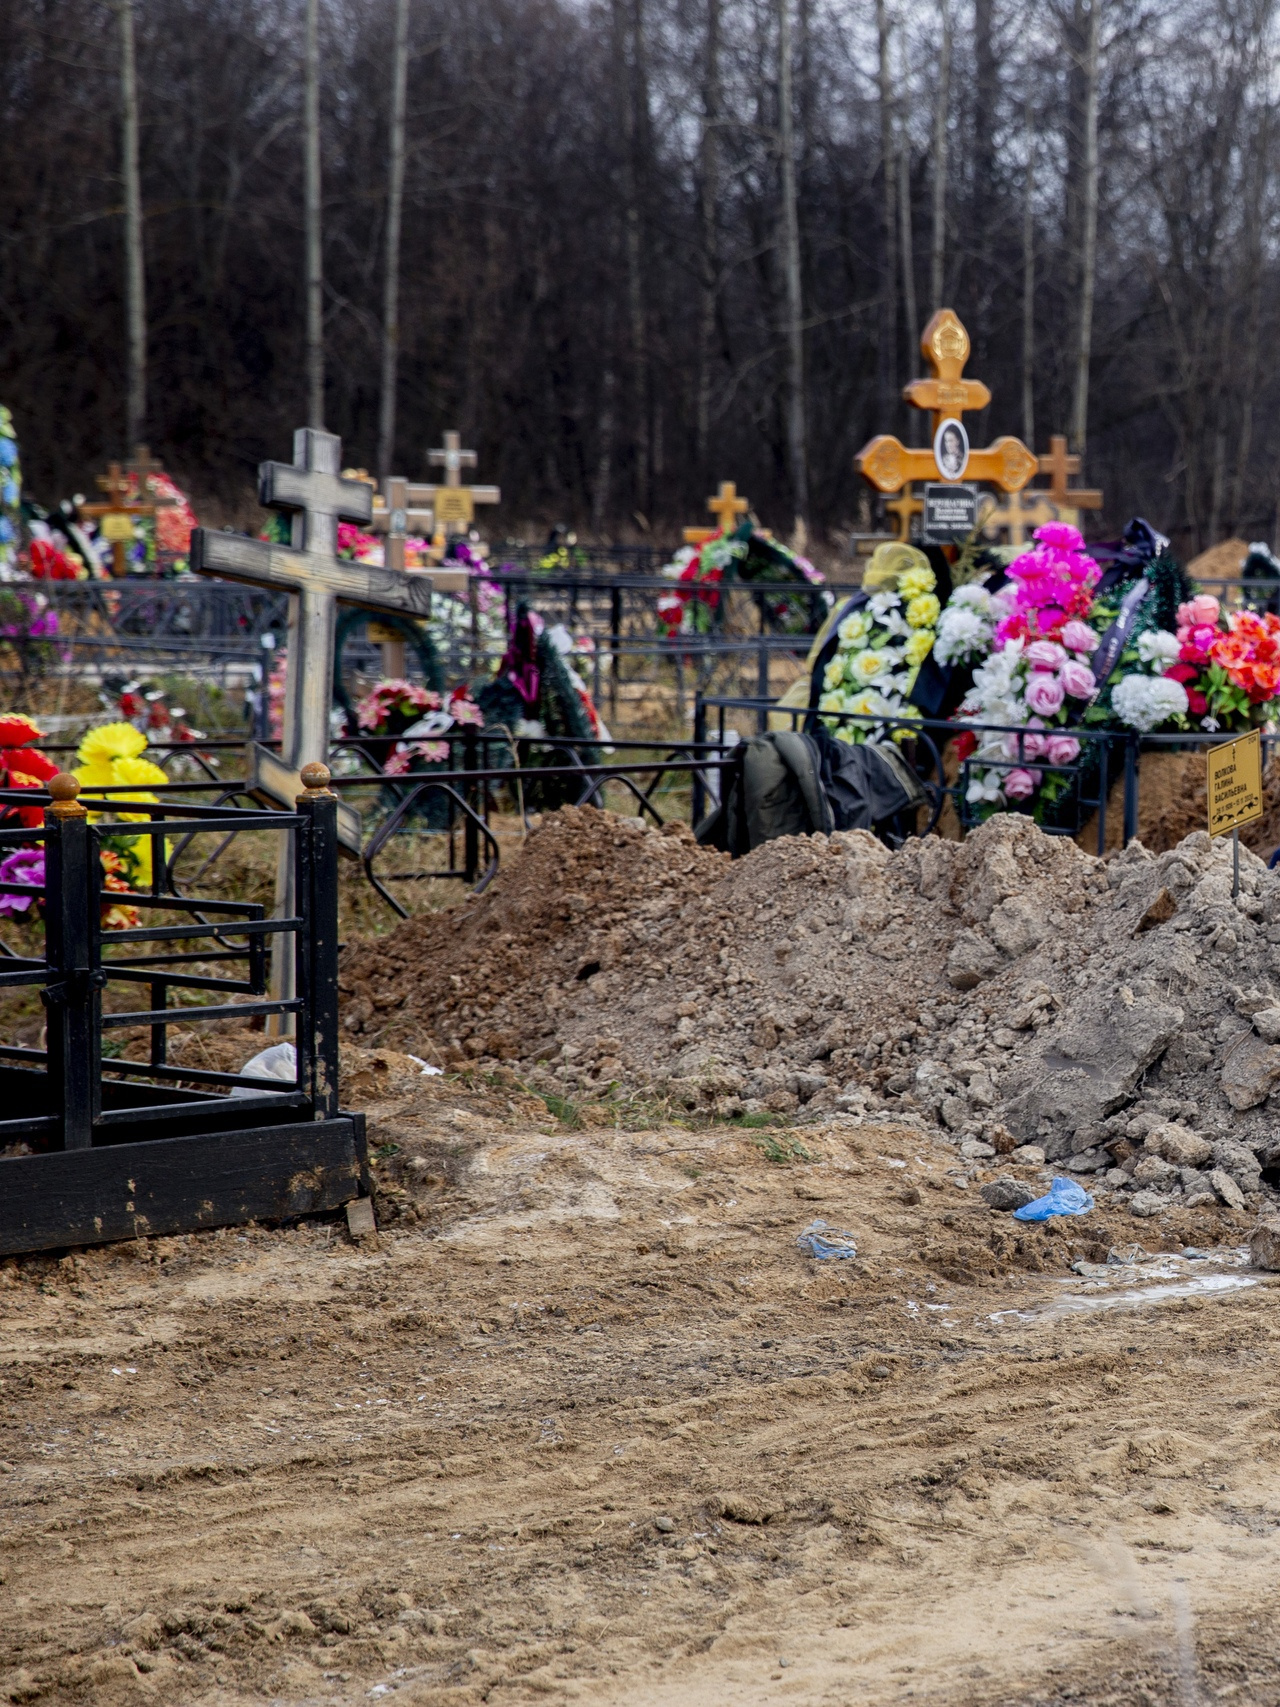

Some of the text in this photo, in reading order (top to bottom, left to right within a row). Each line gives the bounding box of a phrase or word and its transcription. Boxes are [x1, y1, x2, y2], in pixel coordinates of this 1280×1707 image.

[1215, 764, 1236, 780] ВОЛКОВА
[1214, 776, 1233, 792] ГАЛИНА
[1215, 783, 1247, 804] ВАСИЛЬЕВНА
